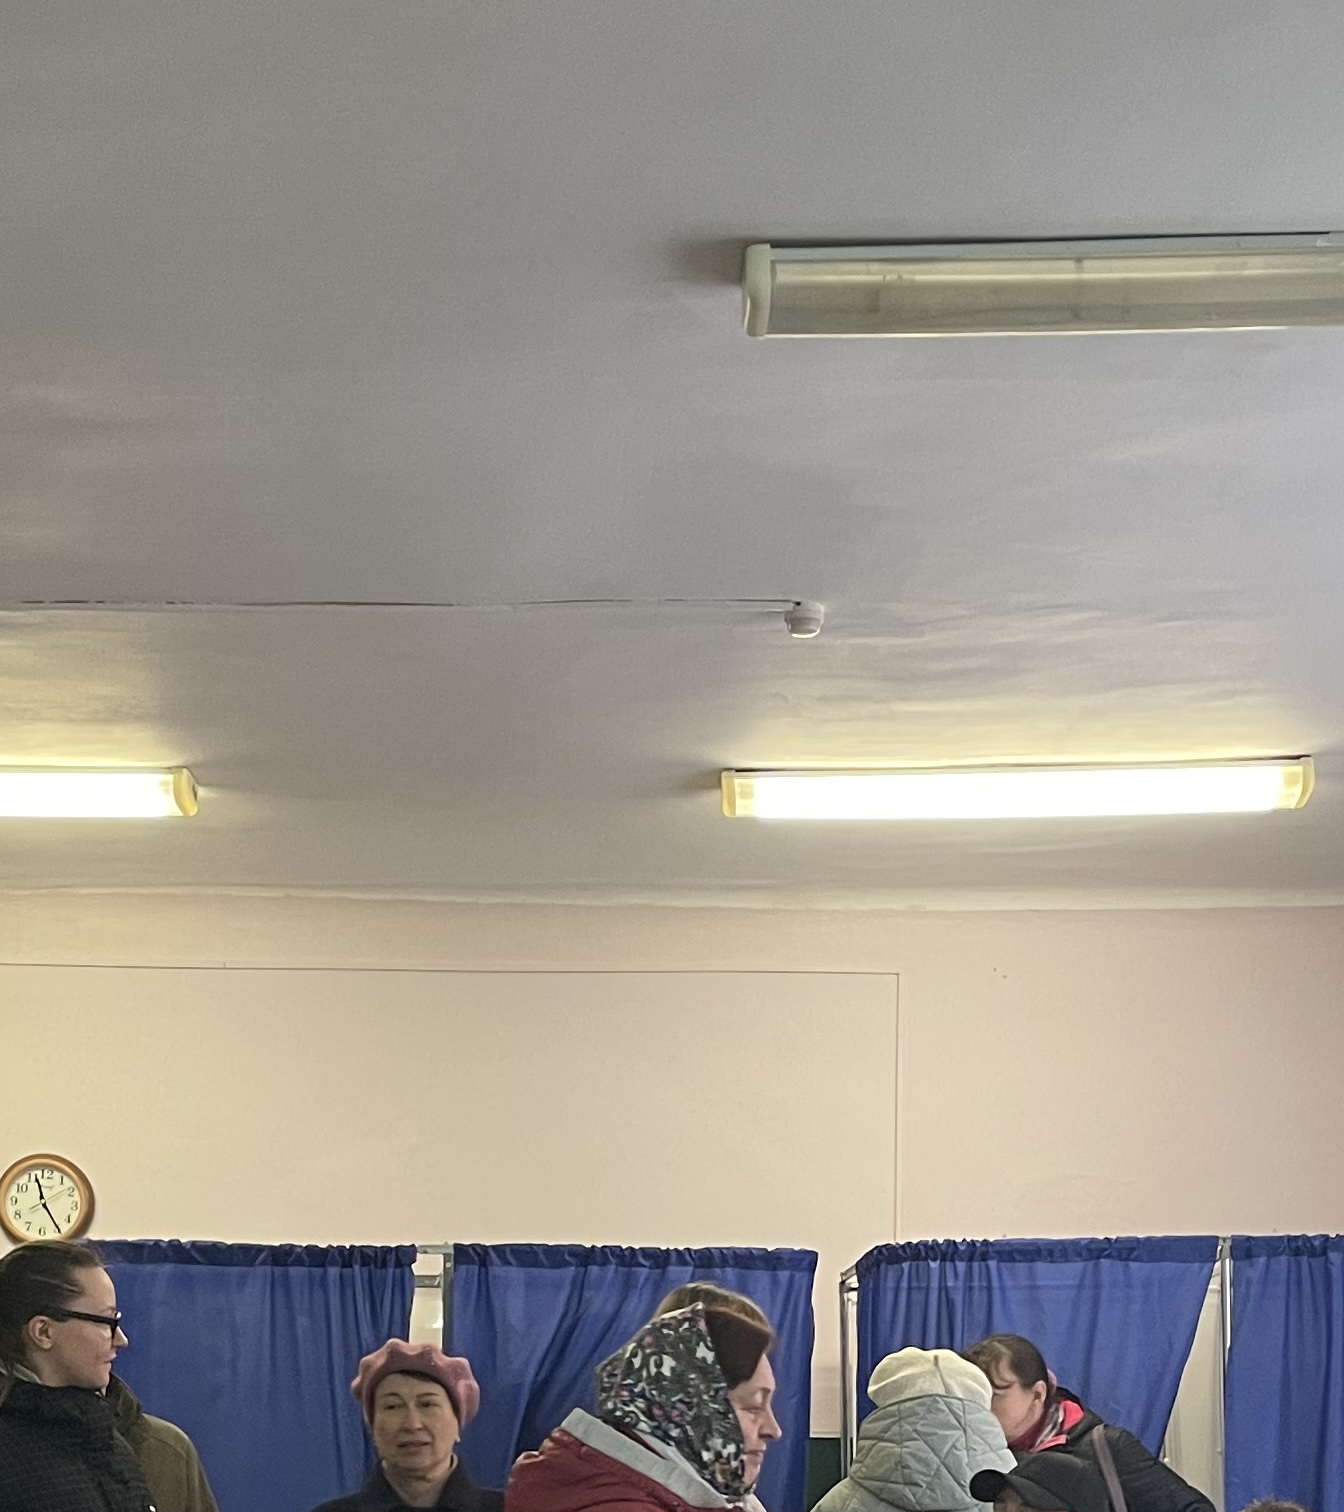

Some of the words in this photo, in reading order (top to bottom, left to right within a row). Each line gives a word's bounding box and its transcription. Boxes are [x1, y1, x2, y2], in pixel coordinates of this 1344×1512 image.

[41, 1169, 55, 1179] 12
[59, 1175, 65, 1185] 1
[16, 1183, 28, 1193] 10
[67, 1186, 76, 1197] 2
[10, 1196, 18, 1206] 9
[71, 1201, 78, 1211] 3
[14, 1210, 21, 1220] 8
[64, 1214, 71, 1223] 4
[25, 1222, 33, 1231] 7
[39, 1226, 46, 1236] 6
